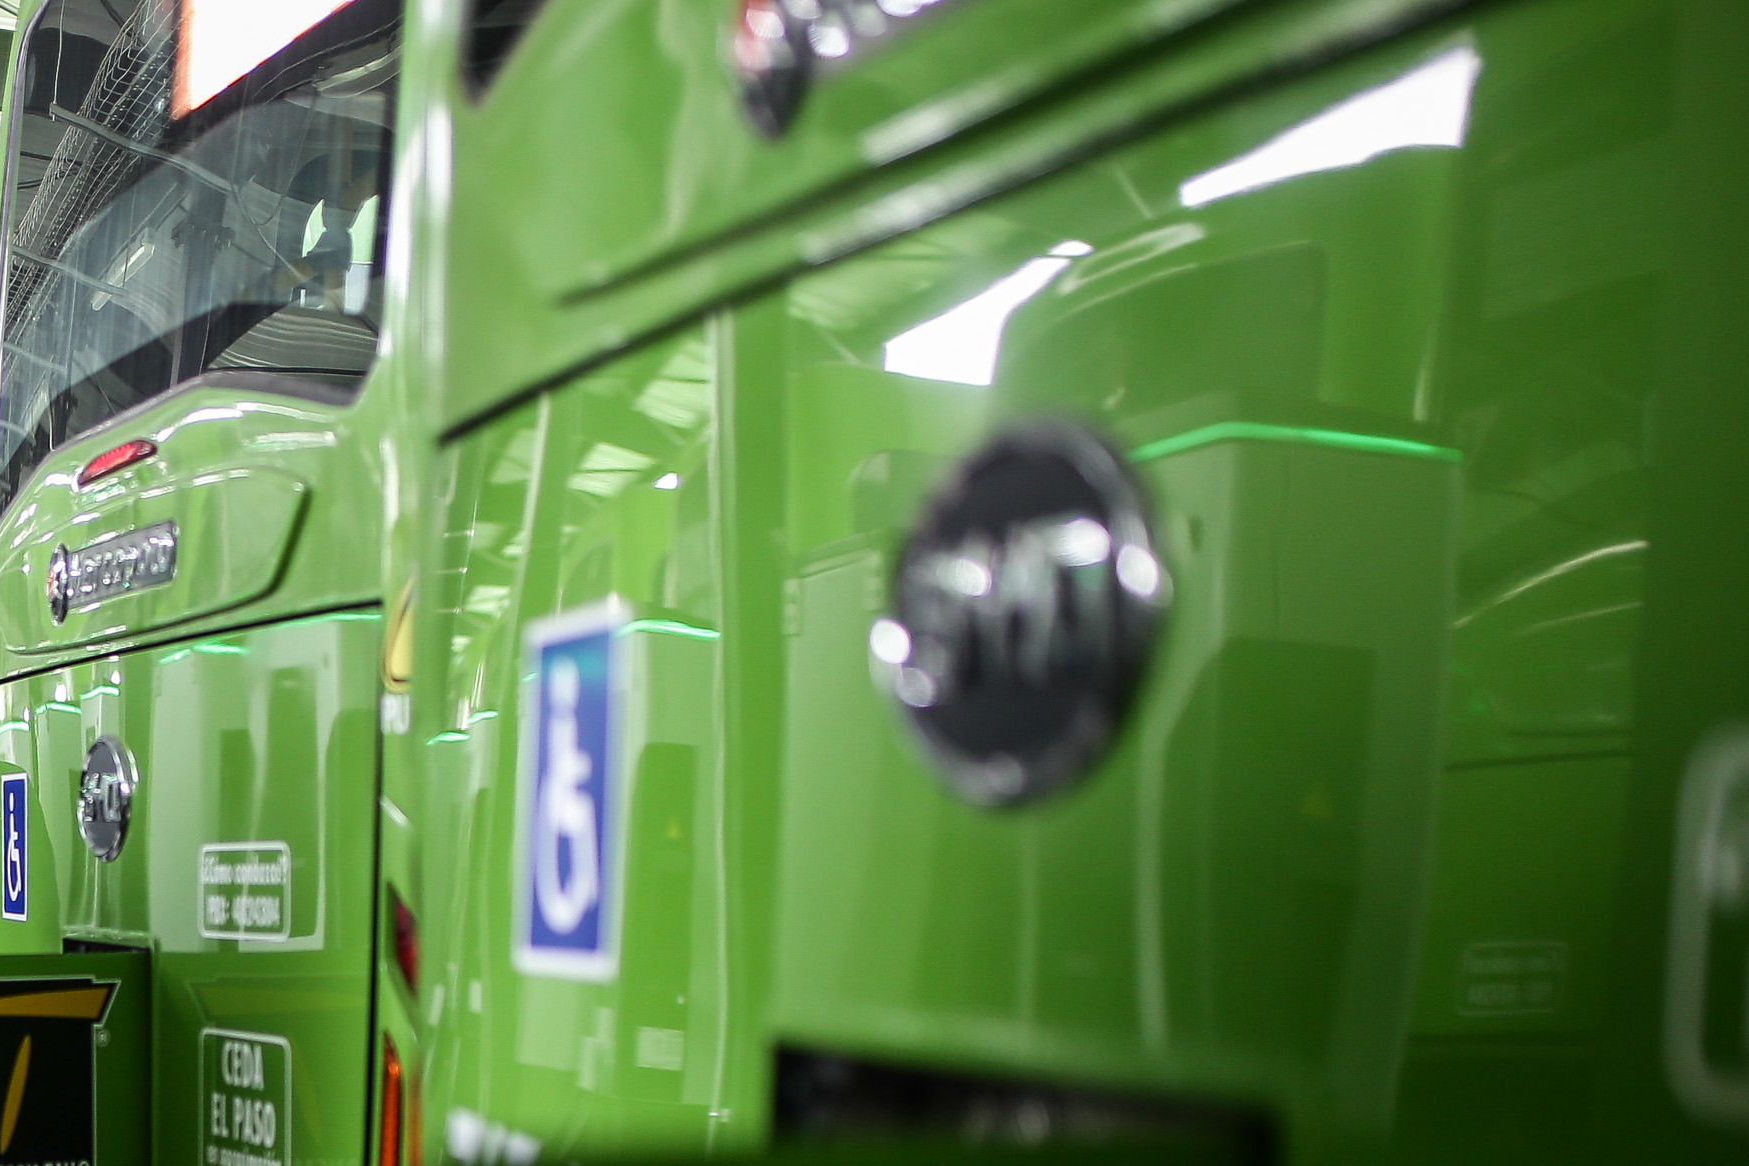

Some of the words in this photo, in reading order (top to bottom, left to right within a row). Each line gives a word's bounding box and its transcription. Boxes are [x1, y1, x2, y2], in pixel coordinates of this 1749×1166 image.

[222, 1040, 264, 1091] CEDA
[211, 1091, 229, 1138] EL
[233, 1096, 276, 1149] PASO
